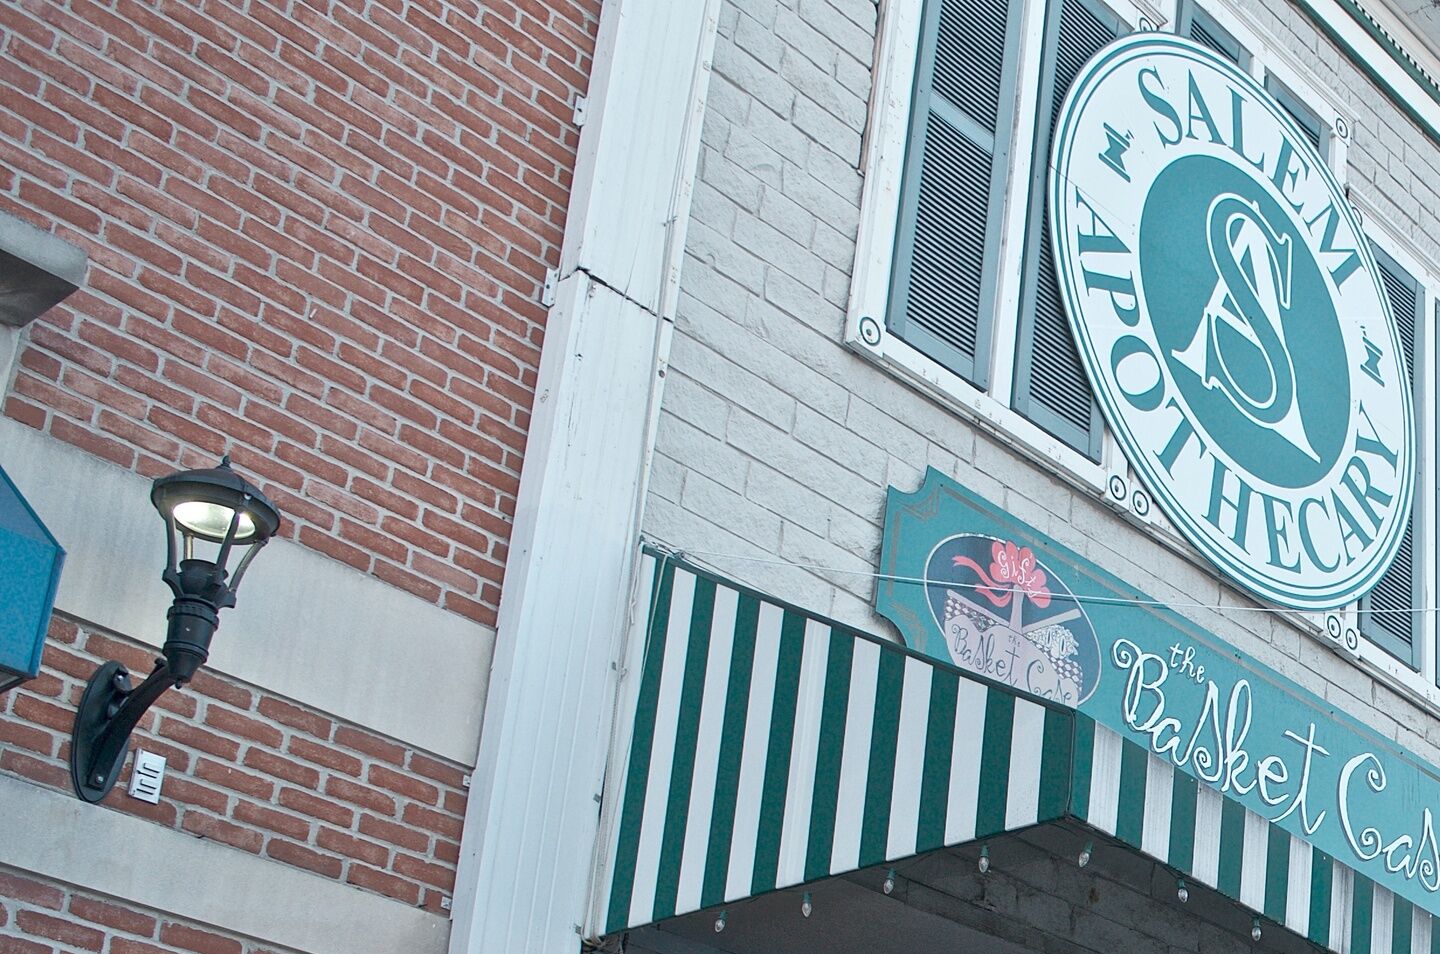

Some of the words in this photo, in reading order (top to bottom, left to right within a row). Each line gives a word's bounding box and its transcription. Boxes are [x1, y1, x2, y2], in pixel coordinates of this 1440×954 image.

[1136, 65, 1367, 296] SALEM
[1075, 188, 1399, 574] APOTHECARY
[1112, 638, 1331, 836] Basket
[1170, 642, 1205, 684] the
